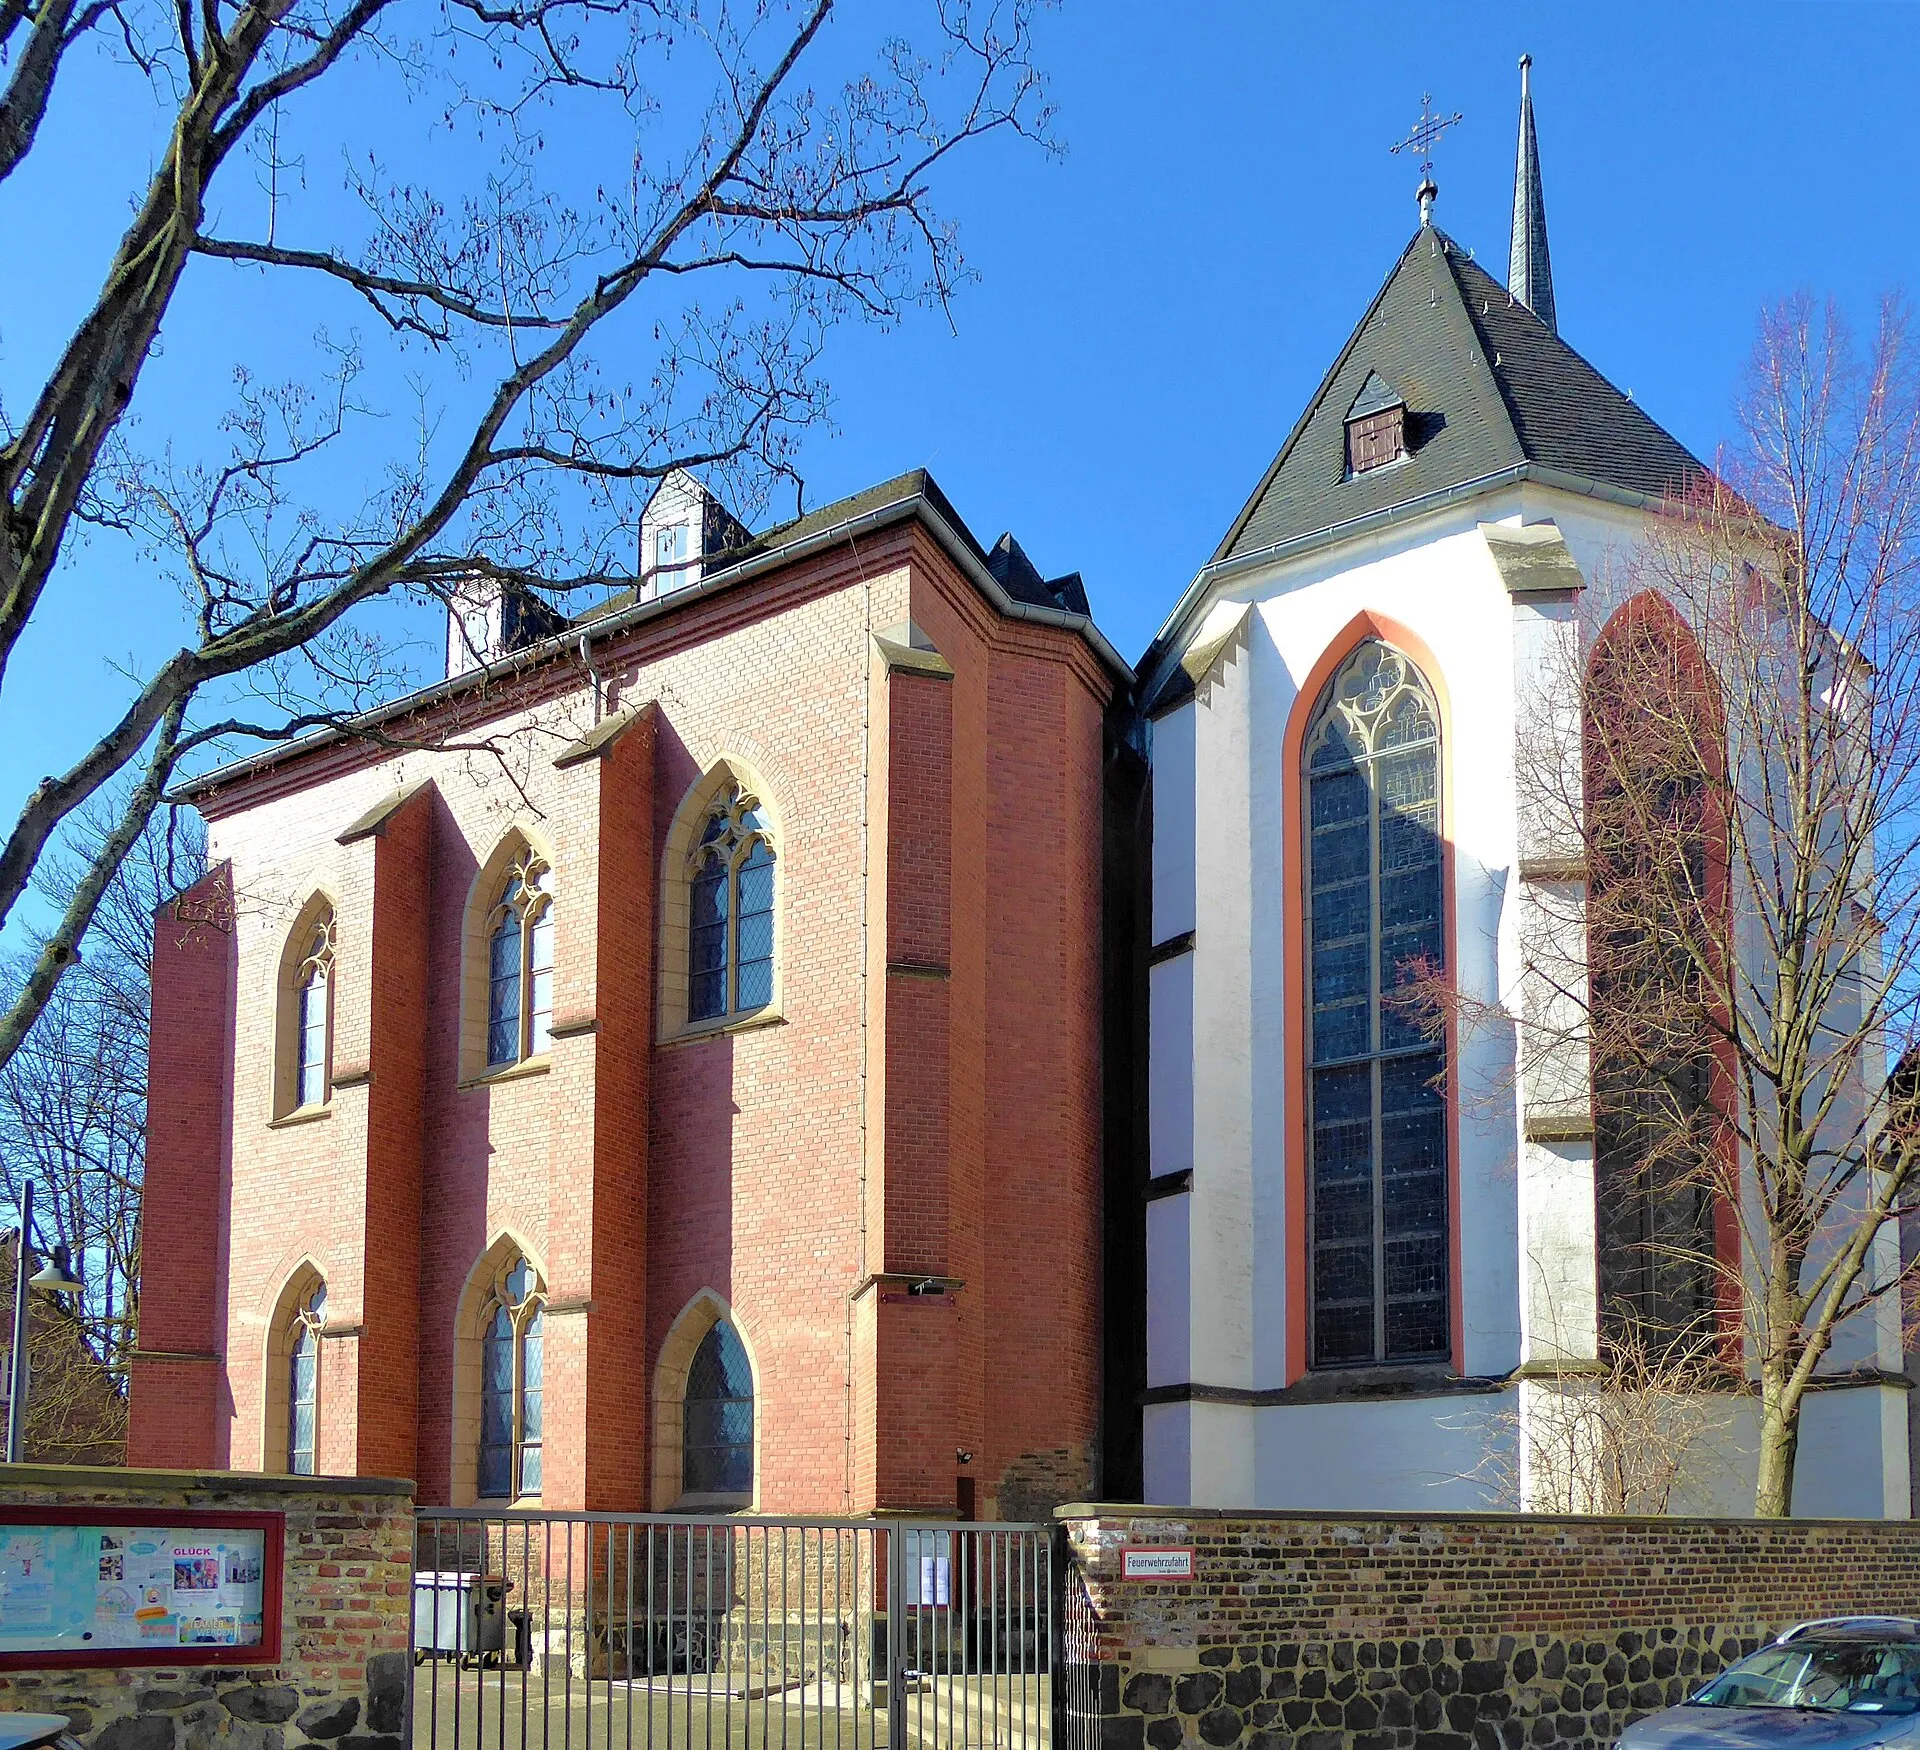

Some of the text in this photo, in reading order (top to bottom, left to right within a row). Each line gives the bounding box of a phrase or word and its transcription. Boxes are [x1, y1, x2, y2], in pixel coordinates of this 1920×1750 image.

[1127, 1556, 1189, 1568] Feuerwehrzufahrt
[190, 1620, 224, 1629] TEAMER
[197, 1628, 234, 1636] WERDEN
